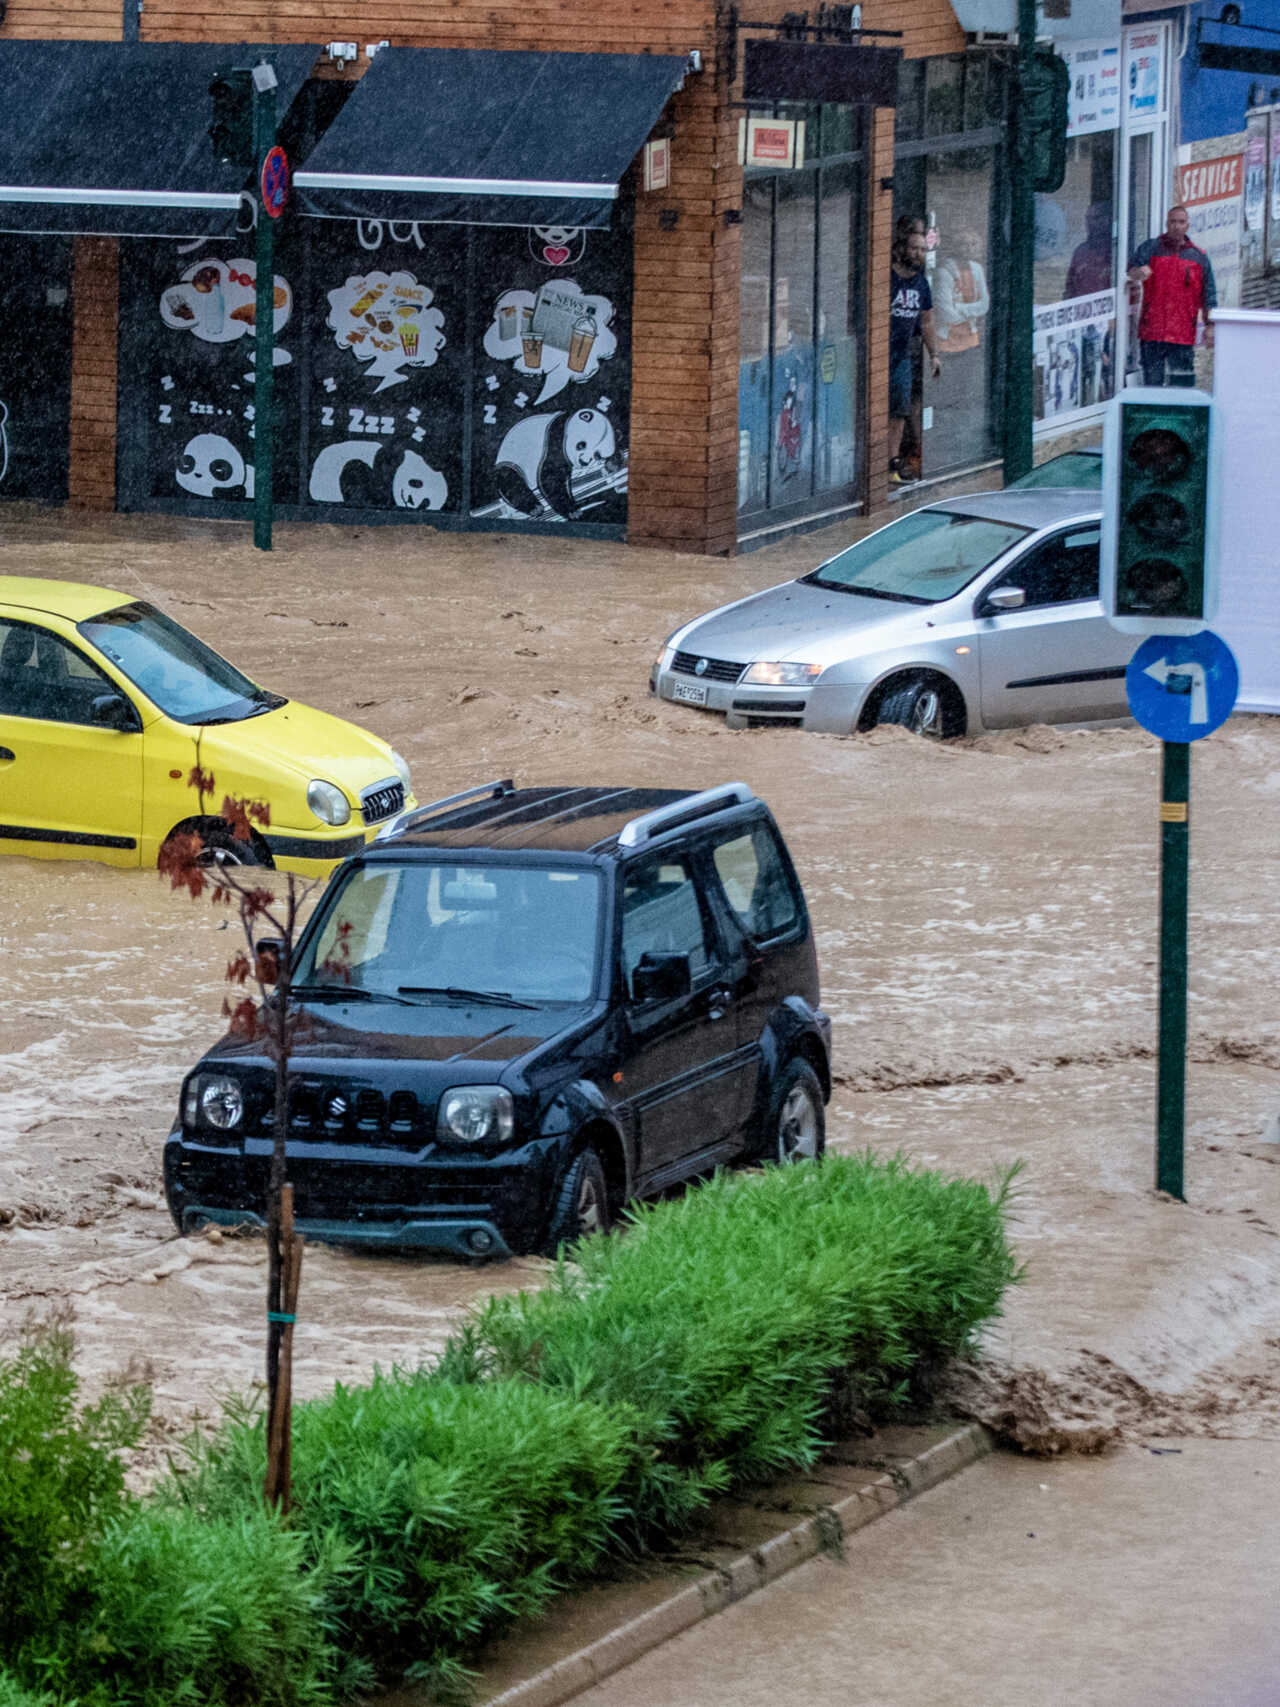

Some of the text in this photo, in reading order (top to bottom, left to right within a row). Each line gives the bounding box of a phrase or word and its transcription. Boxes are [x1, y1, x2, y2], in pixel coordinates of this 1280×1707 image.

[1181, 159, 1239, 204] SERVICE
[555, 293, 585, 312] NEWS
[891, 289, 920, 308] AIR
